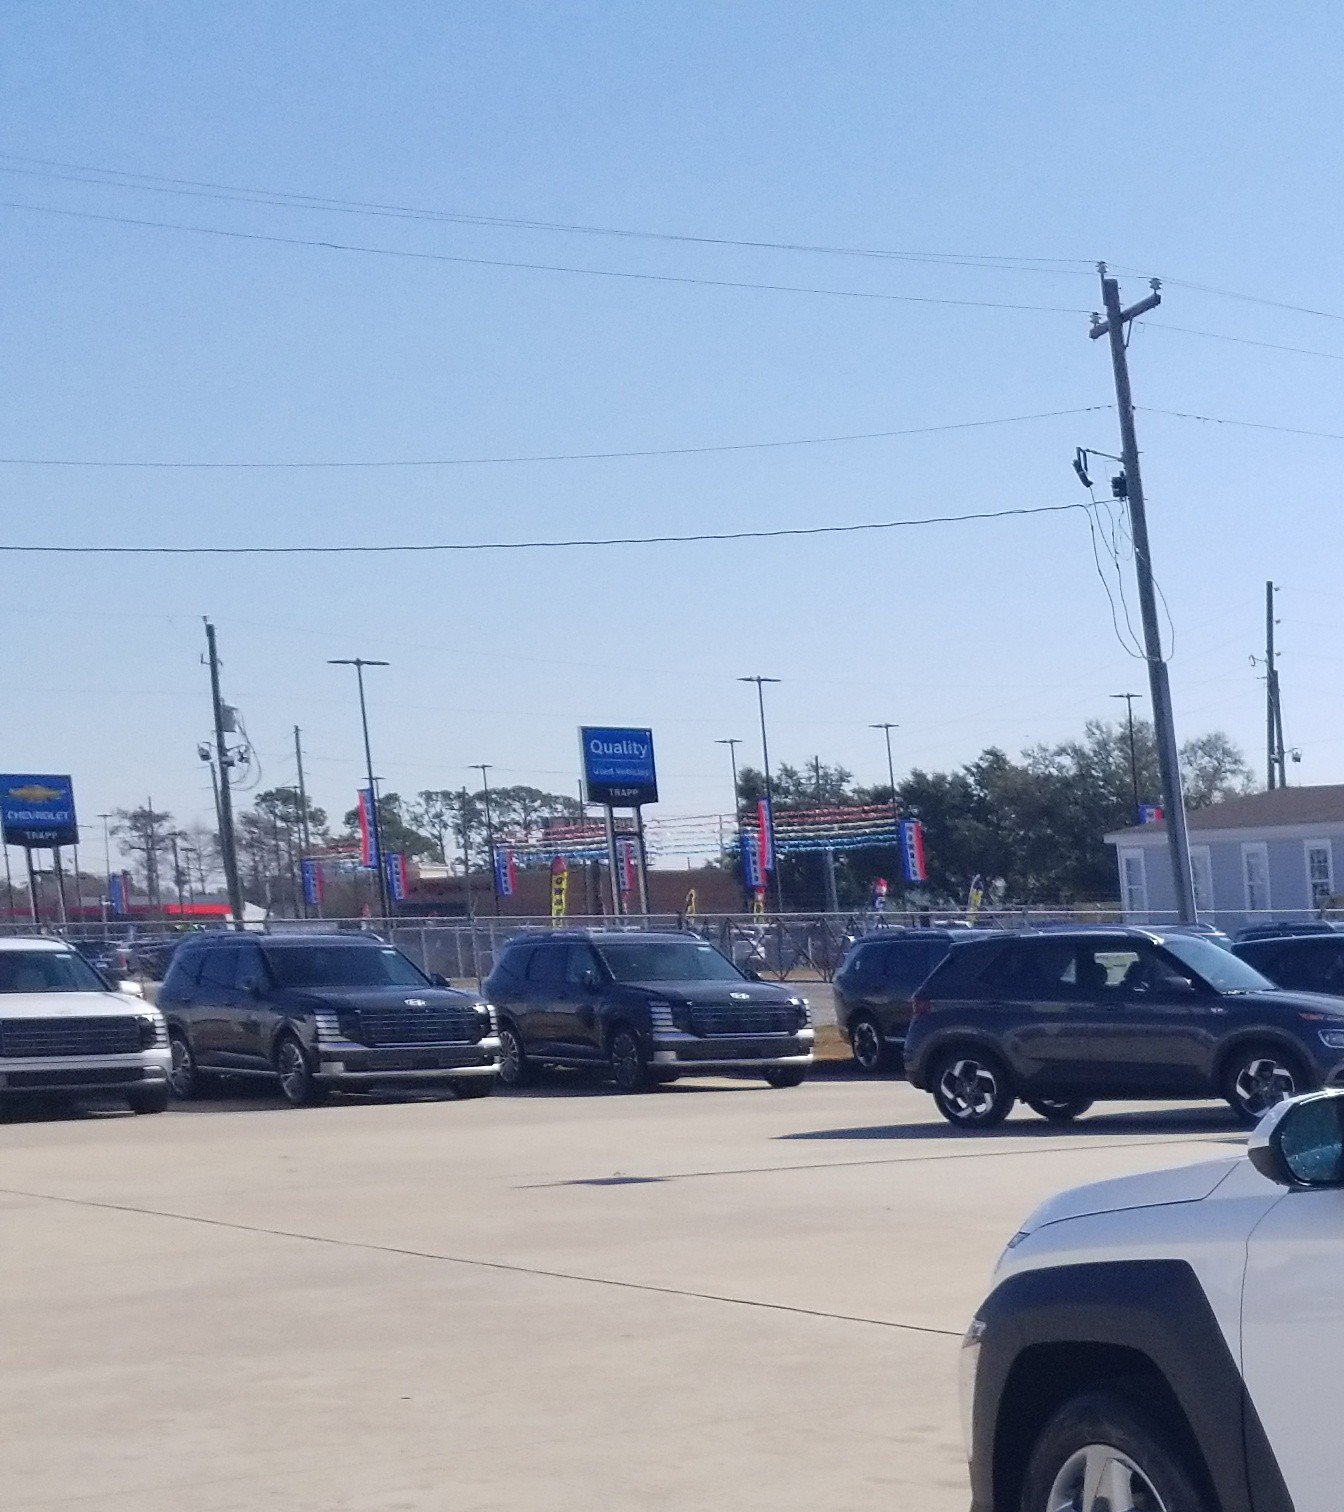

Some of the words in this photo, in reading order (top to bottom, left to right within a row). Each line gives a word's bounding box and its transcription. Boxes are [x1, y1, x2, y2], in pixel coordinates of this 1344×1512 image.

[589, 739, 648, 758] Quality
[608, 788, 639, 797] TRAPP
[7, 811, 69, 820] CHEVROLET
[25, 831, 58, 839] TRAPP
